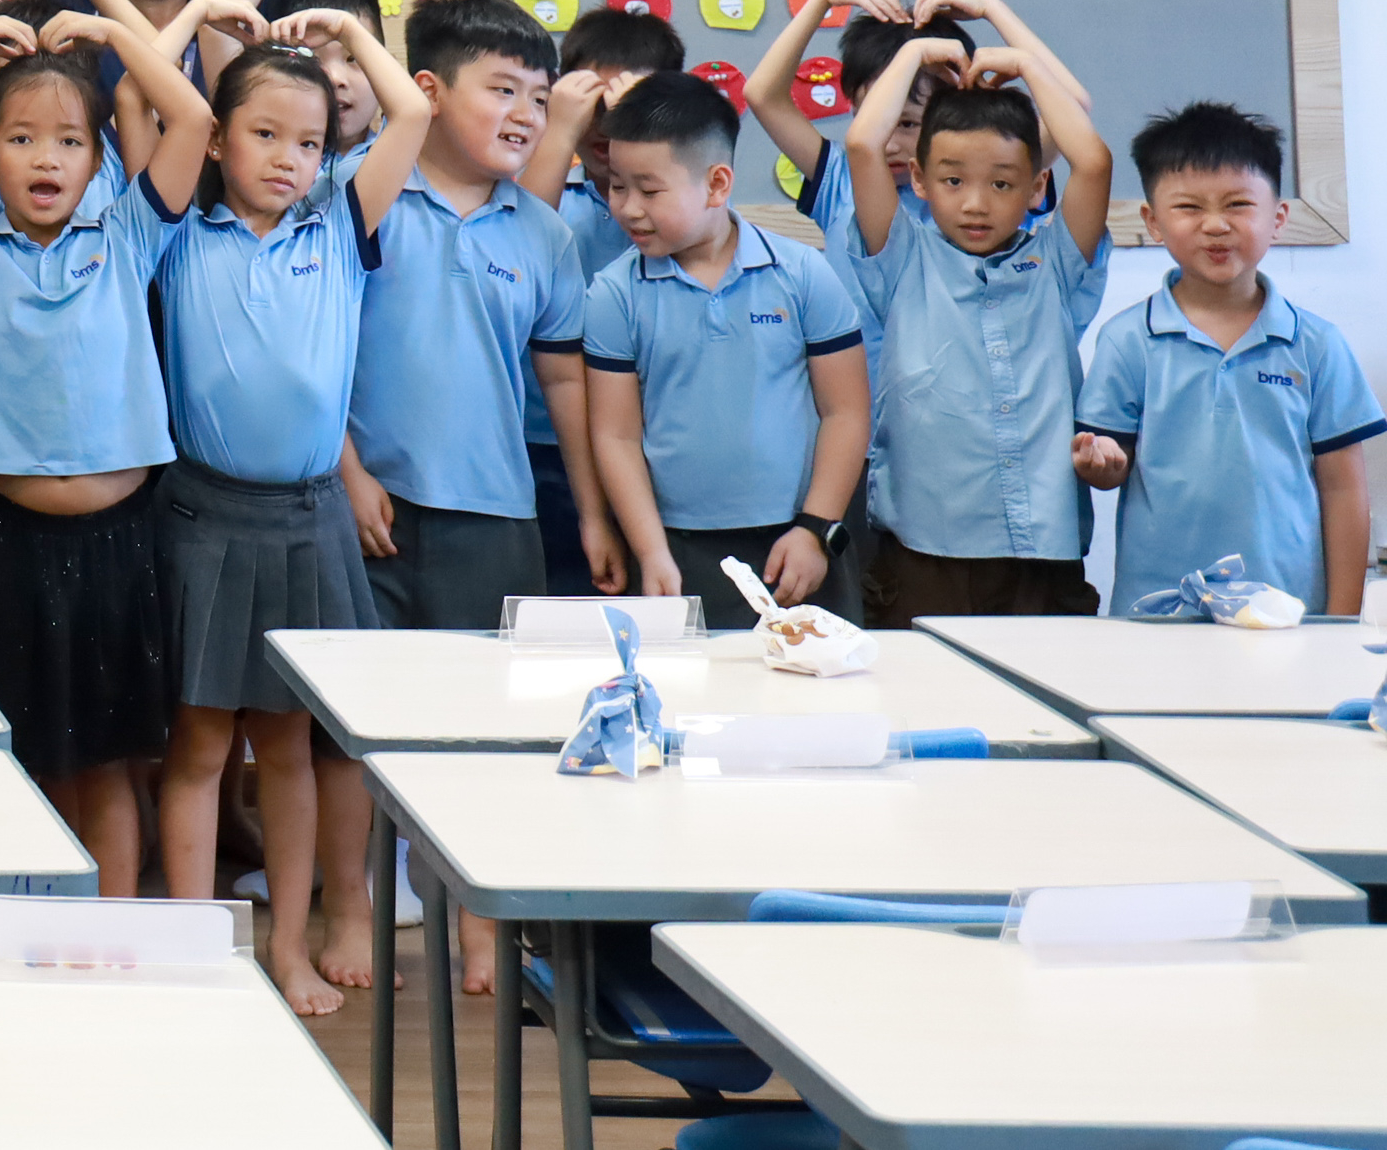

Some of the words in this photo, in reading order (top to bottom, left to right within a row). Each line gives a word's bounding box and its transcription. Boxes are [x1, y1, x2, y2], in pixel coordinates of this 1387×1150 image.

[70, 260, 99, 279] bms
[292, 262, 318, 276] bms
[487, 262, 515, 283] bms
[1012, 259, 1035, 273] bms
[749, 312, 781, 324] bms
[1257, 370, 1292, 386] bms
